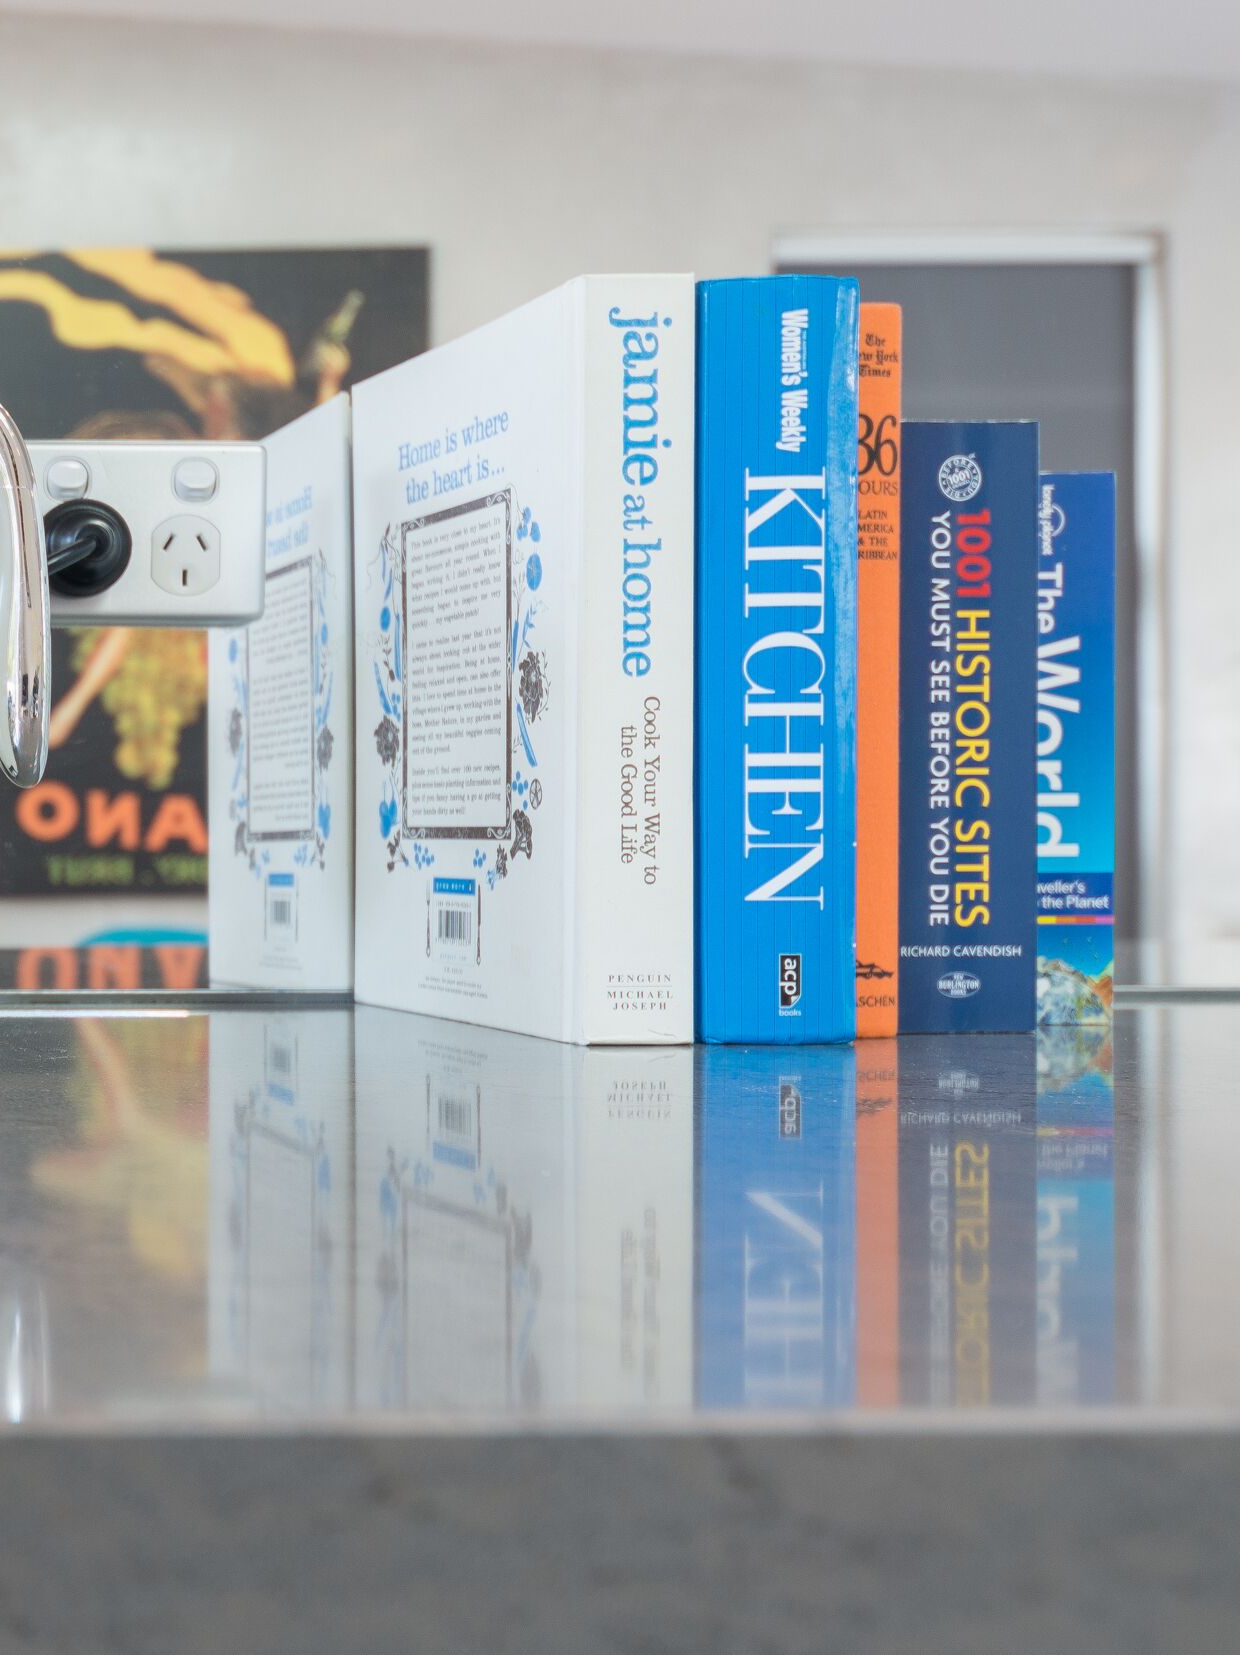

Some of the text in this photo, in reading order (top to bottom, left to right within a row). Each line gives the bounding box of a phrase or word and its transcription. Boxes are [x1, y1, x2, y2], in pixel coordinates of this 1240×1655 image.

[865, 333, 886, 347] The
[775, 308, 808, 453] Women's Weekly
[398, 411, 510, 473] Home is where
[405, 476, 430, 505] the
[432, 462, 473, 498] heart
[858, 480, 898, 496] OURS
[609, 307, 673, 677] jamie at home
[858, 523, 894, 534] MERICA
[858, 551, 898, 560] RIBBEAN
[743, 467, 825, 911] KITCHEN
[955, 509, 991, 927] 1001 HISTORIC SITES
[1037, 563, 1081, 857] The World
[929, 511, 951, 926] YOU MUST SEE BEFORE YOU DIE
[620, 725, 638, 864] the Good Life
[640, 696, 661, 886] Cook Your Way to
[1042, 895, 1109, 910] the Planet
[900, 945, 1022, 957] RICHARD CAVENDISH
[608, 974, 672, 983] PENGUIN
[779, 957, 797, 995] acp
[938, 979, 979, 990] BURLINGTON
[607, 991, 673, 1000] MICHAEL
[856, 996, 895, 1007] SCHEN
[612, 1002, 667, 1011] JOSEPH
[779, 1008, 802, 1017] books
